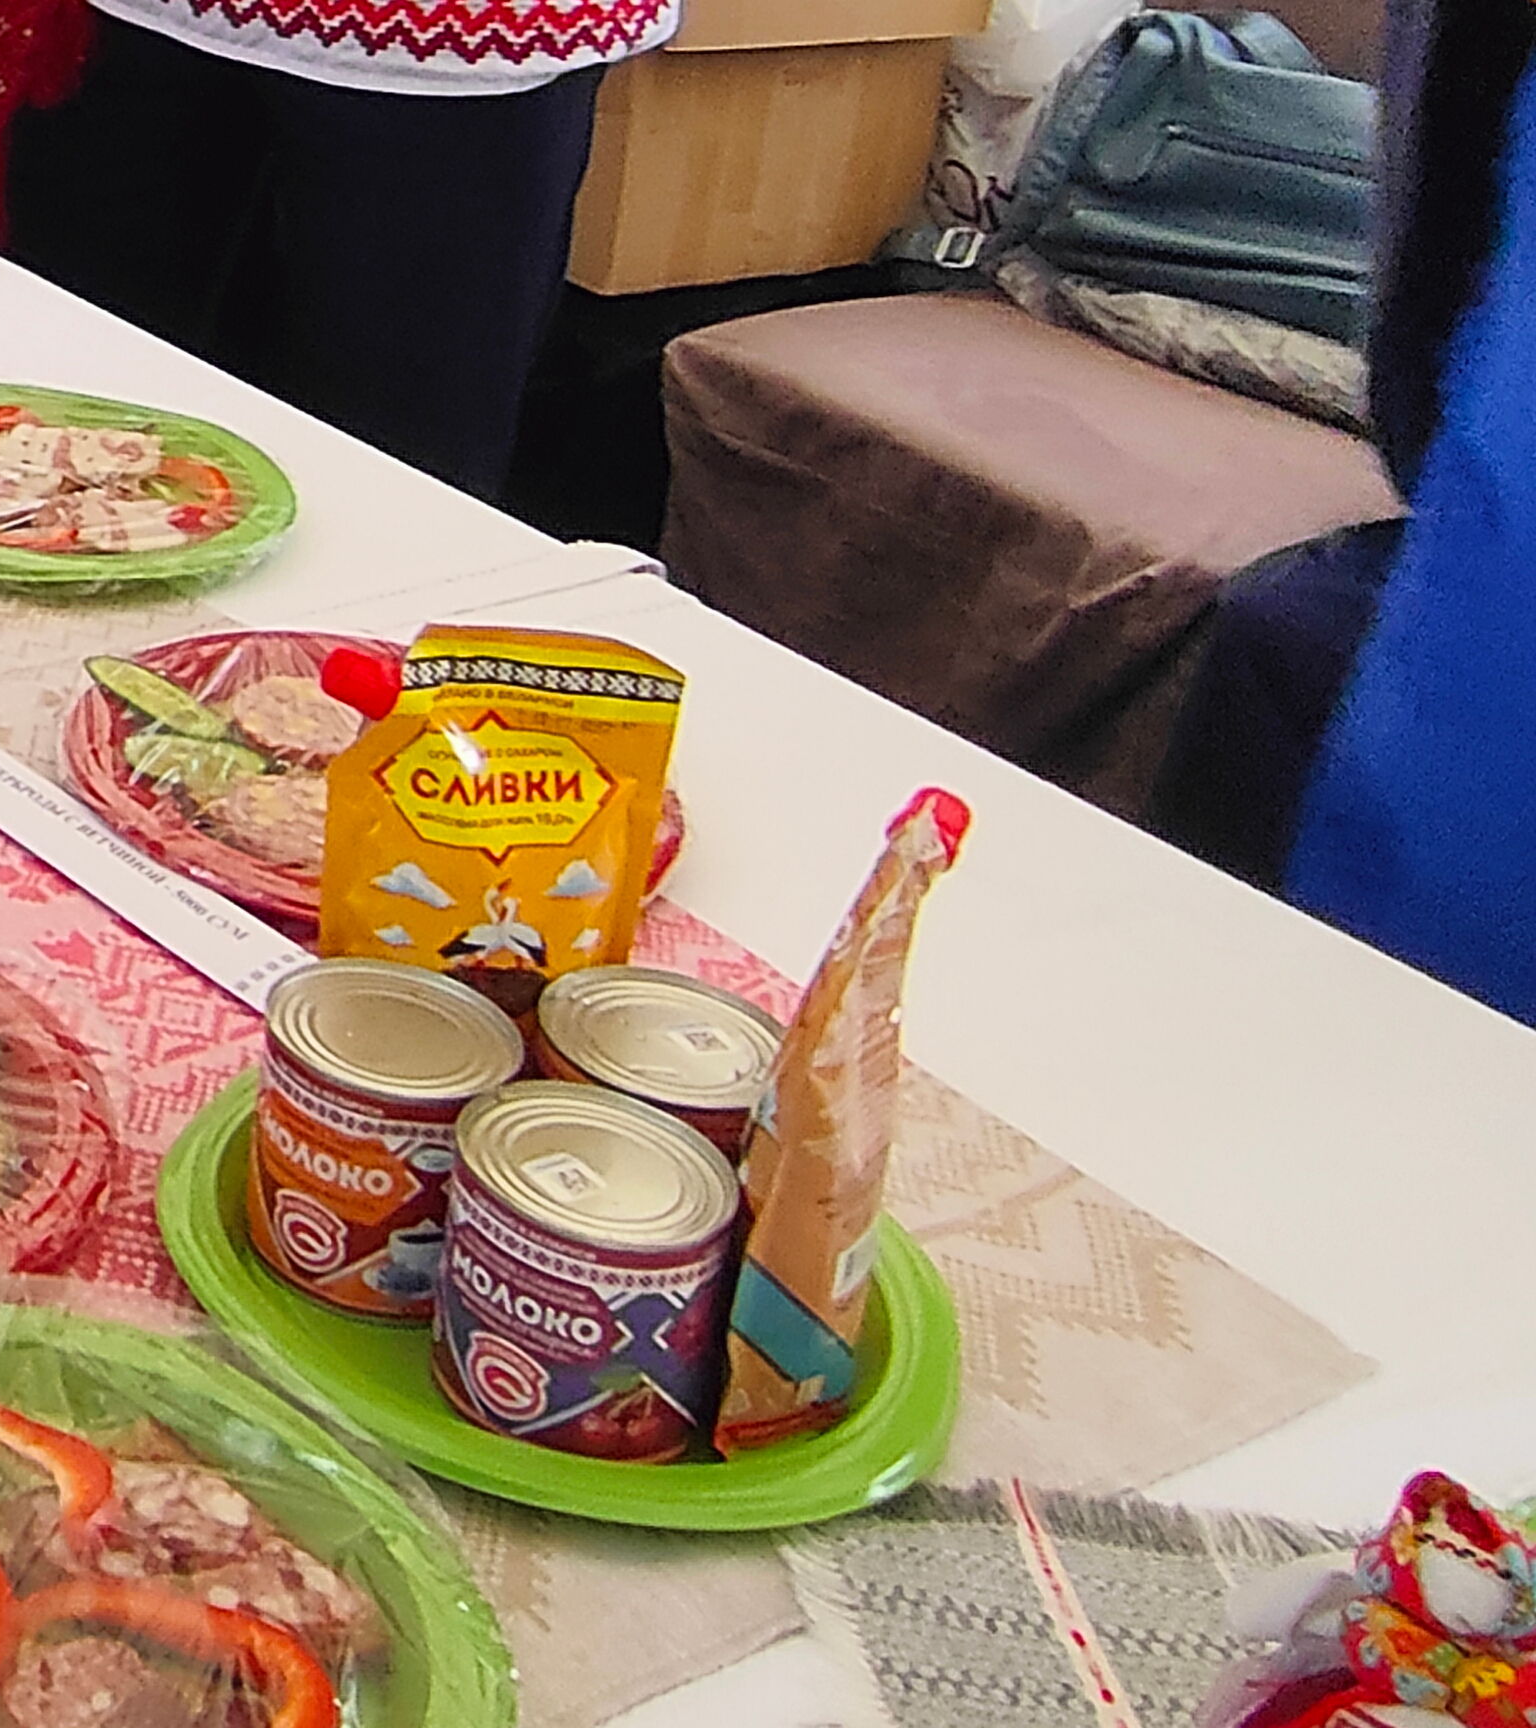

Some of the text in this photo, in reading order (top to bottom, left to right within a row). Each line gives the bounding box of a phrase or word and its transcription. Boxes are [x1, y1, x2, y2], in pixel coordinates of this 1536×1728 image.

[409, 767, 585, 807] СЛИВКИ
[261, 1106, 393, 1196] МОЛОКО
[451, 1244, 603, 1346] МОЛОКО
